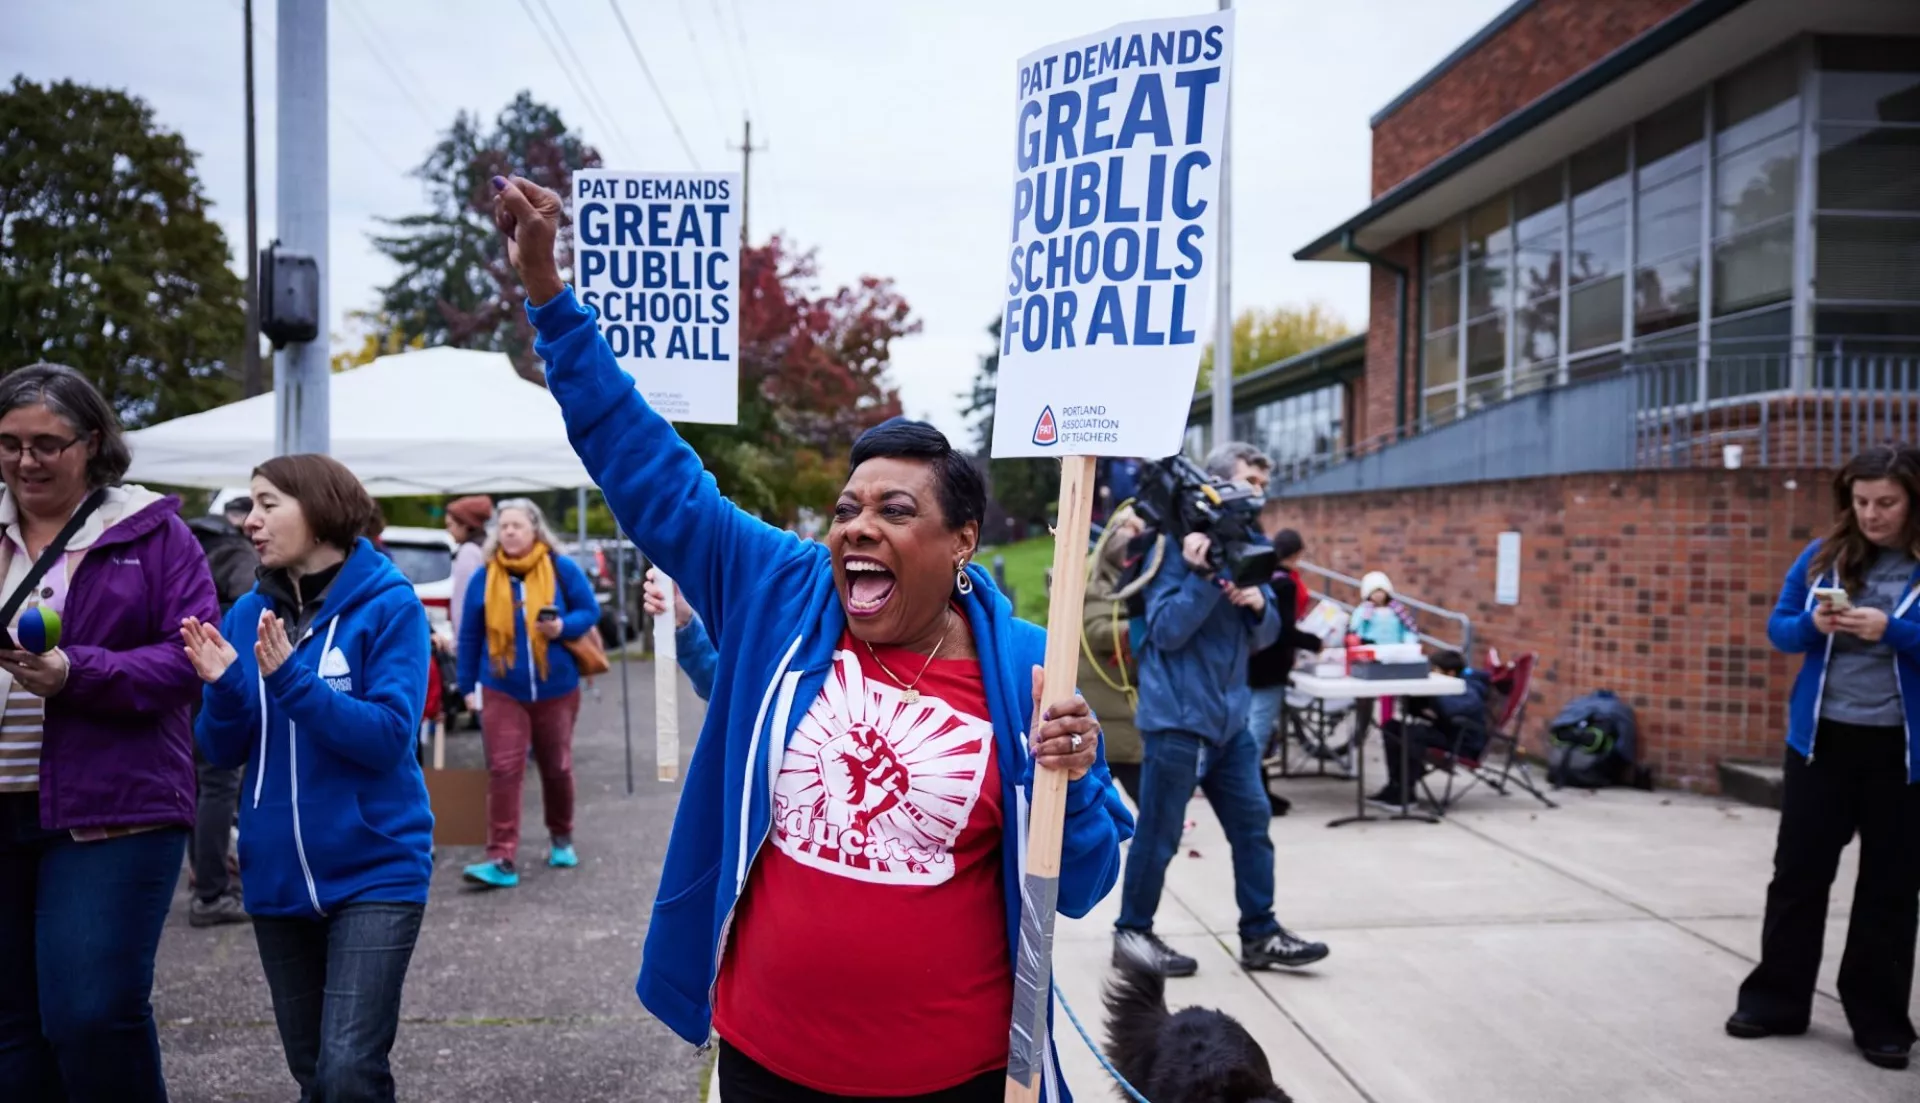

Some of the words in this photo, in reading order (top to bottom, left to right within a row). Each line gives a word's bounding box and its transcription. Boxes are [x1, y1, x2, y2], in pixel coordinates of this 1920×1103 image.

[1019, 56, 1058, 101] PAT
[1063, 25, 1224, 85] DEMANDS
[1016, 66, 1221, 173] GREAT
[578, 179, 619, 199] PAT
[625, 179, 730, 200] DEMANDS
[1011, 150, 1212, 244] PUBLIC
[579, 202, 730, 247] GREAT
[580, 250, 730, 291] PUBLIC
[1008, 224, 1205, 297] SCHOOLS
[582, 291, 730, 325] SCHOOLS
[1003, 290, 1078, 357] FOR
[1085, 284, 1197, 347] ALL
[598, 324, 656, 359] OR
[666, 326, 730, 361] ALL
[1040, 424, 1053, 435] PAT
[1061, 418, 1120, 430] ASSOCIATION
[1062, 405, 1107, 417] PORTLAND
[1061, 432, 1071, 443] OF
[1072, 432, 1119, 443] TEACHERS
